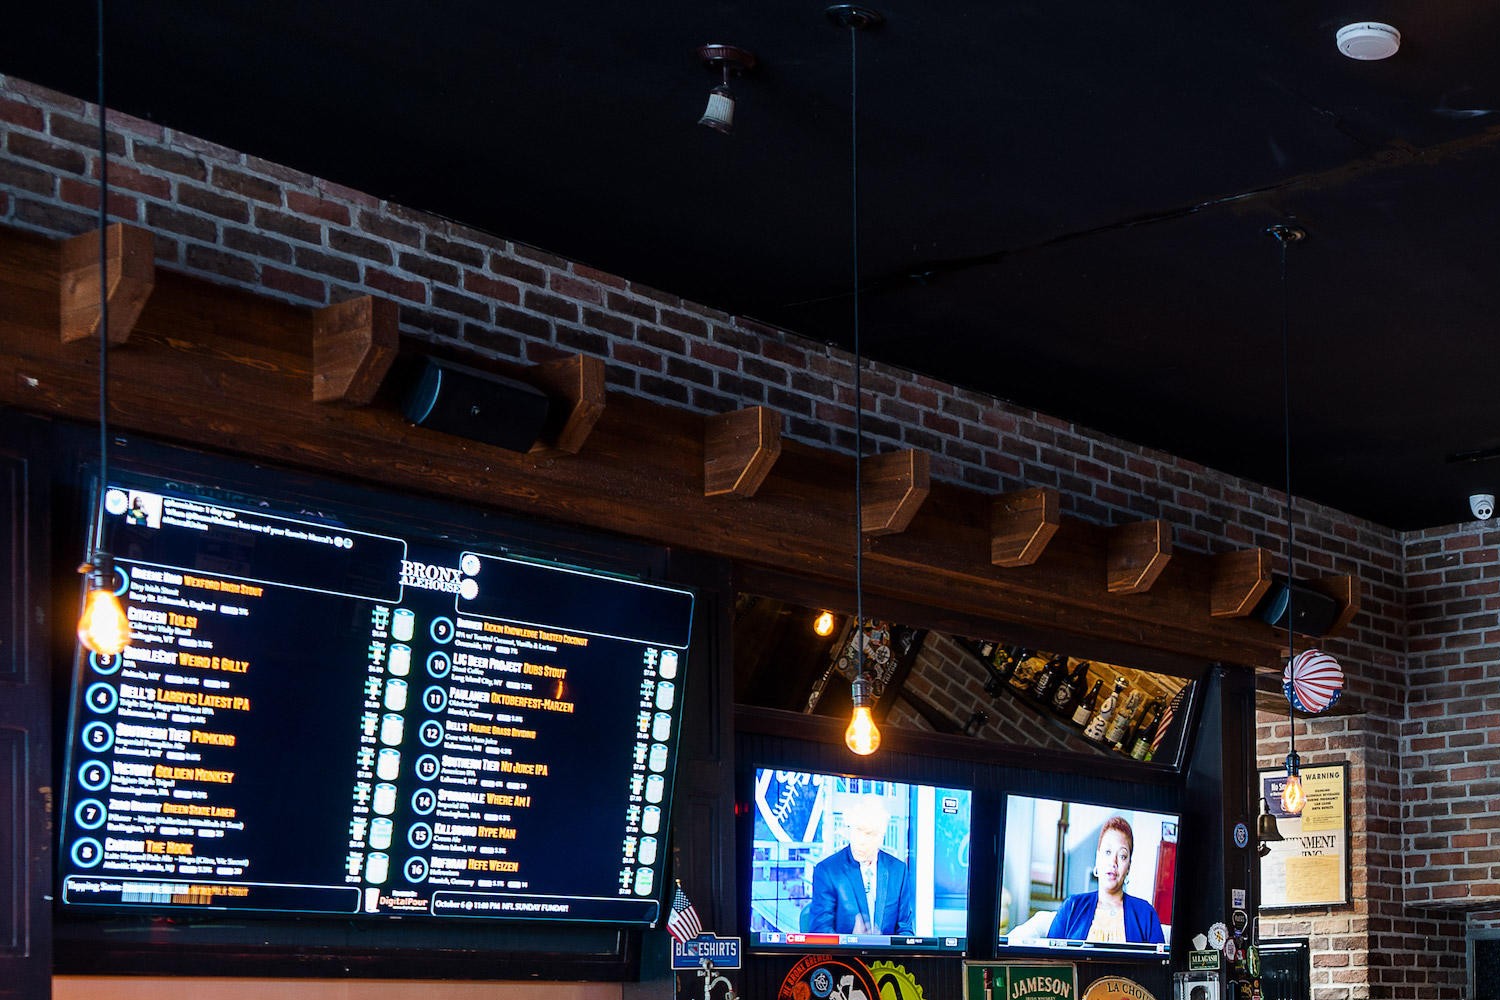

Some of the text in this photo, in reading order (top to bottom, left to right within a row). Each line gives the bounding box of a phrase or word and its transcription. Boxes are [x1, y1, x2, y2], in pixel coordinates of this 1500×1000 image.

[400, 560, 463, 585] BRONX
[399, 575, 463, 594] ALEHOUSE
[168, 612, 197, 628] TULSI
[438, 625, 446, 635] 9
[101, 653, 111, 665] 3
[433, 659, 445, 670] 10
[488, 657, 522, 672] PROJECT
[523, 662, 543, 675] DUBS
[543, 665, 566, 678] STOUT
[97, 692, 106, 703] 4
[156, 688, 197, 704] LARRY'S
[198, 692, 233, 708] LATEST
[233, 696, 250, 710] IPA
[430, 694, 440, 704] 11
[490, 692, 573, 712] OKTOBERFEST-MARZEN
[93, 730, 103, 742] 5
[426, 728, 437, 739] 12
[422, 762, 433, 772] 13
[512, 762, 534, 774] JUICE
[534, 764, 548, 775] IPA
[89, 769, 100, 780] 6
[155, 764, 194, 780] GOLDEN
[194, 767, 234, 783] MONKEY
[1305, 772, 1340, 780] WARNING
[418, 796, 430, 807] 14
[485, 793, 513, 805] WHERE
[514, 795, 526, 806] AM
[85, 808, 96, 819] 7
[414, 830, 426, 840] 15
[478, 826, 498, 837] HYPE
[498, 827, 516, 839] MAN
[82, 847, 92, 857] 8
[145, 840, 165, 853] THE
[411, 864, 422, 874] 16
[467, 858, 518, 872] HEFE WEIZEN
[379, 896, 427, 907] DigitalPour
[675, 942, 737, 957] BLESHIRTS
[1012, 976, 1070, 1000] JAMESON
[1107, 982, 1120, 993] LA
